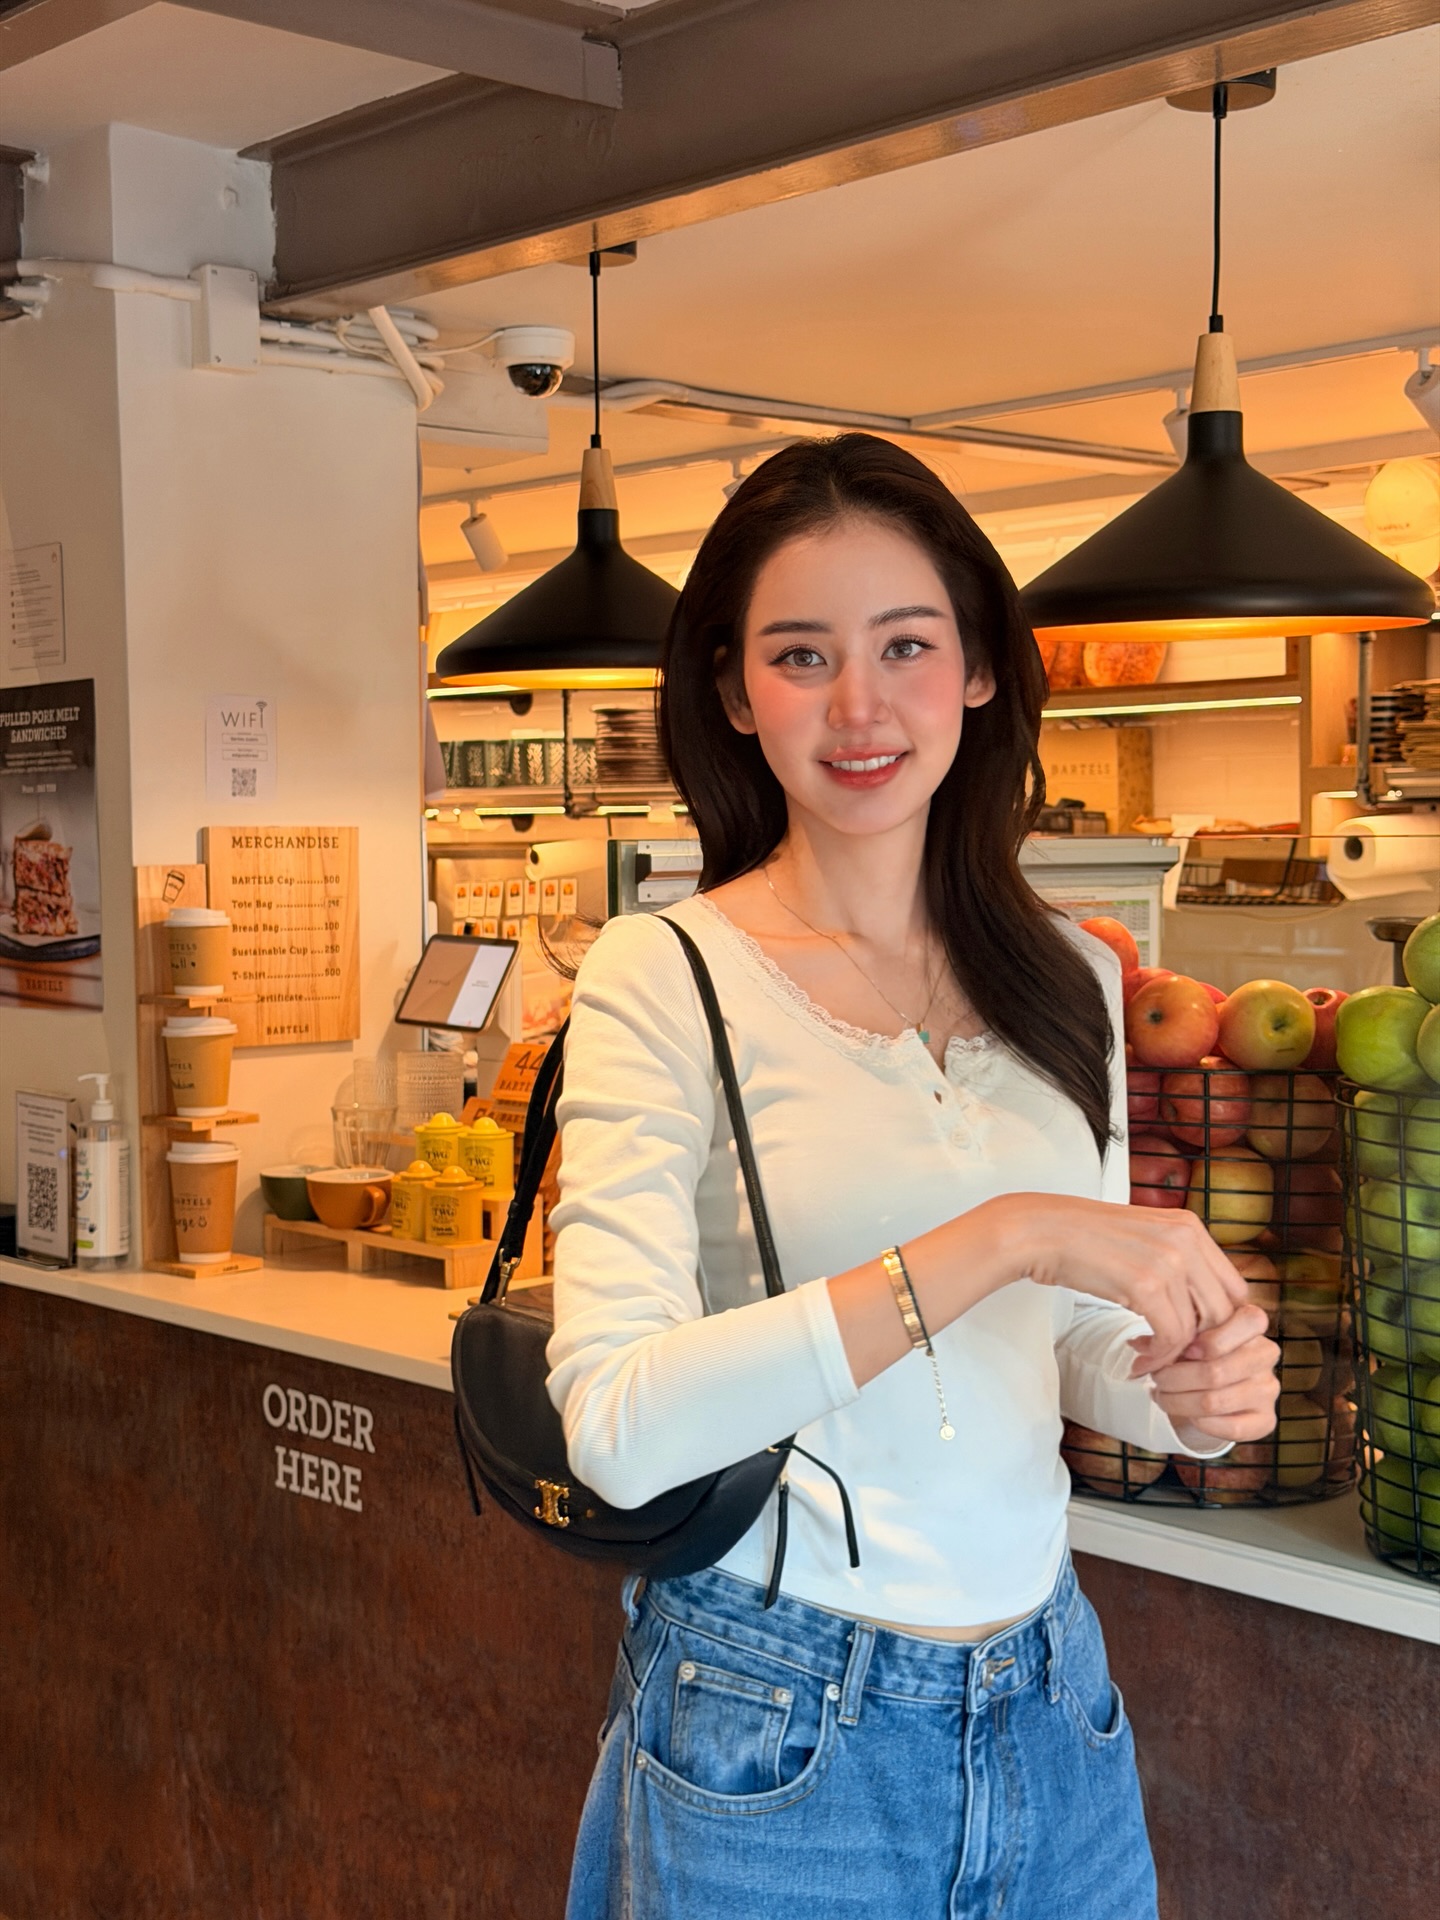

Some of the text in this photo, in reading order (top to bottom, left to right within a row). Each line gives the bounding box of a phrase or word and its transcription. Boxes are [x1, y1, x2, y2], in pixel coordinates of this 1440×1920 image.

[0, 706, 80, 727] PULLED PORK MELT
[11, 725, 67, 743] SANDWICHES
[231, 836, 340, 849] MERCHANDISE
[232, 875, 274, 885] BARTELS
[277, 875, 295, 886] Cap
[231, 900, 252, 909] Tote
[256, 900, 273, 910] Bag
[232, 923, 259, 933] Bread
[262, 923, 279, 934] Bag
[232, 946, 287, 956] Sustainable
[289, 946, 308, 957] Cup
[266, 1024, 310, 1036] BARTELS
[426, 1150, 448, 1160] TWG
[468, 1157, 490, 1167] TWG
[432, 1207, 455, 1217] TWG
[262, 1383, 376, 1454] ORDER
[274, 1444, 363, 1513] HERE
